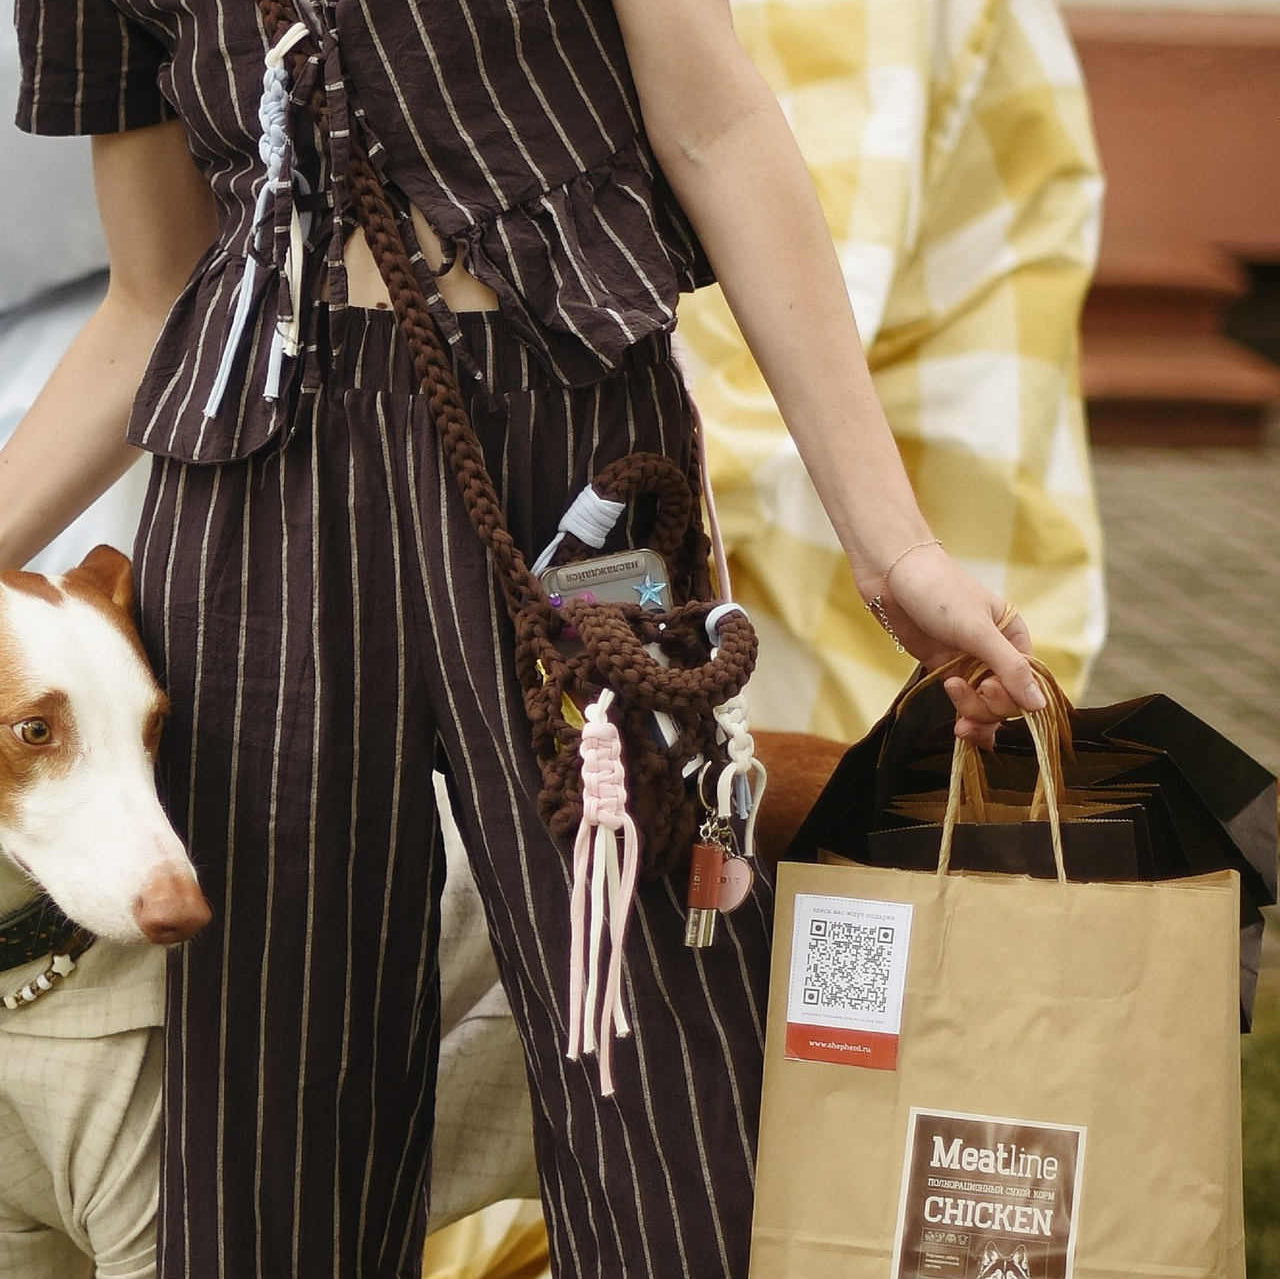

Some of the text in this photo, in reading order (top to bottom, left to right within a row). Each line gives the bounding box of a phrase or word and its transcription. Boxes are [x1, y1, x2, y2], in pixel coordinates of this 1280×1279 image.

[566, 560, 639, 583] наслаждайся
[808, 1040, 871, 1053] www.shepherd.ru
[930, 1135, 1058, 1181] Meatline
[928, 1177, 1055, 1200] ПОЛНОРАЦИОННЫЙ СУХОЙ КОРМ
[924, 1195, 1054, 1237] CHICKEN
